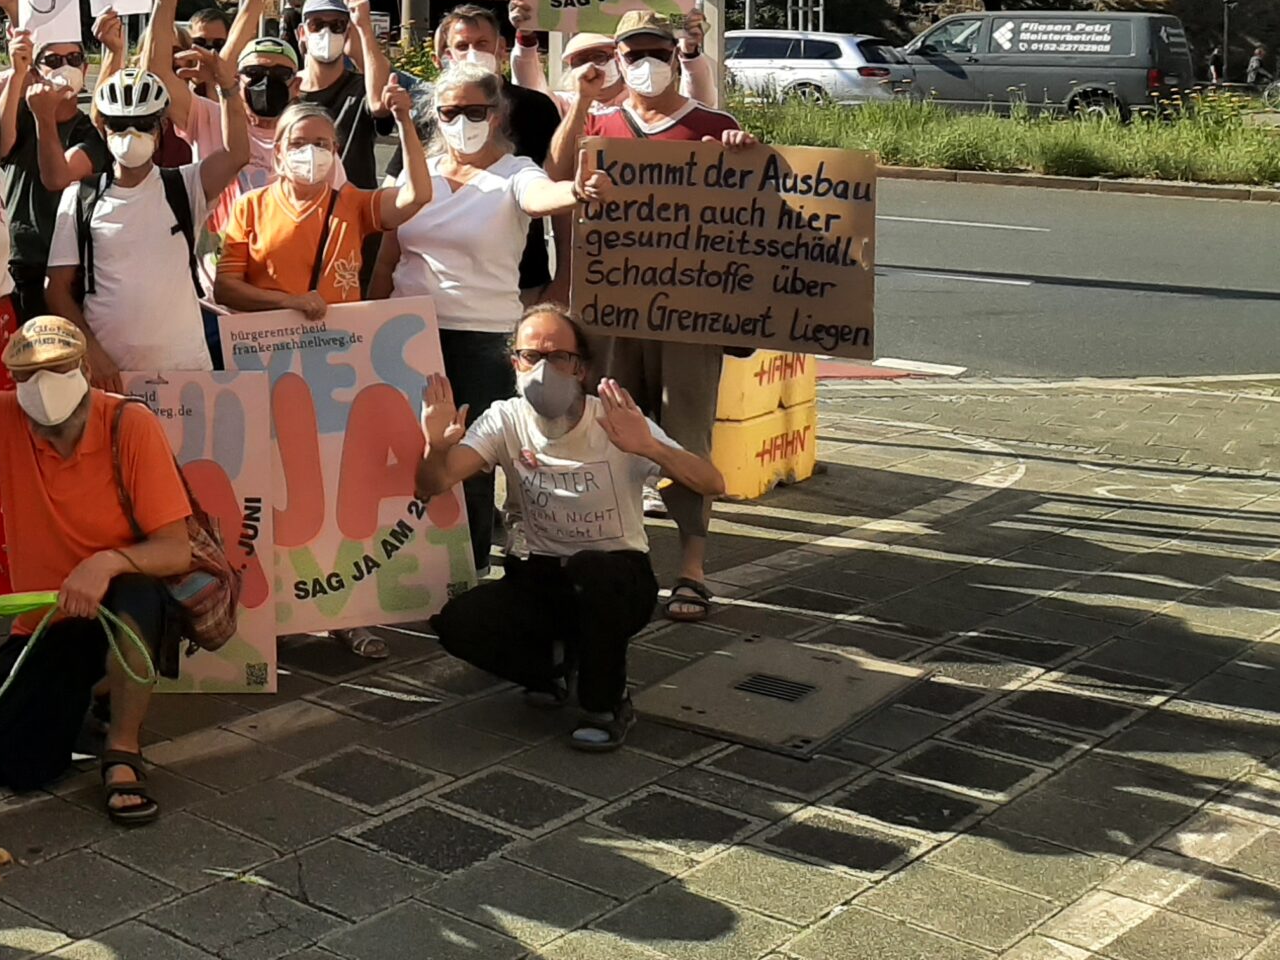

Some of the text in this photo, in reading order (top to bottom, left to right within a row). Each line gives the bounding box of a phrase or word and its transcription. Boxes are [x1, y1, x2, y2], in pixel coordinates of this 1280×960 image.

[1020, 22, 1112, 32] Fliesen Petri
[1020, 32, 1112, 42] Meisterbetrieb
[596, 149, 874, 202] kommt der Ausbau
[700, 197, 765, 228] auch
[777, 199, 841, 233] hier
[585, 257, 837, 298] Schadstoffe über
[230, 321, 327, 343] bürgerentscheid
[581, 294, 639, 331] dem
[646, 292, 775, 338] Grenzwert
[232, 332, 364, 356] frankenschnellweg.de
[272, 372, 460, 547] JA
[237, 497, 262, 557] JUNI
[566, 508, 616, 523] NICHT
[294, 572, 346, 601] SAG
[351, 553, 381, 582] JA
[380, 518, 415, 560] AM
